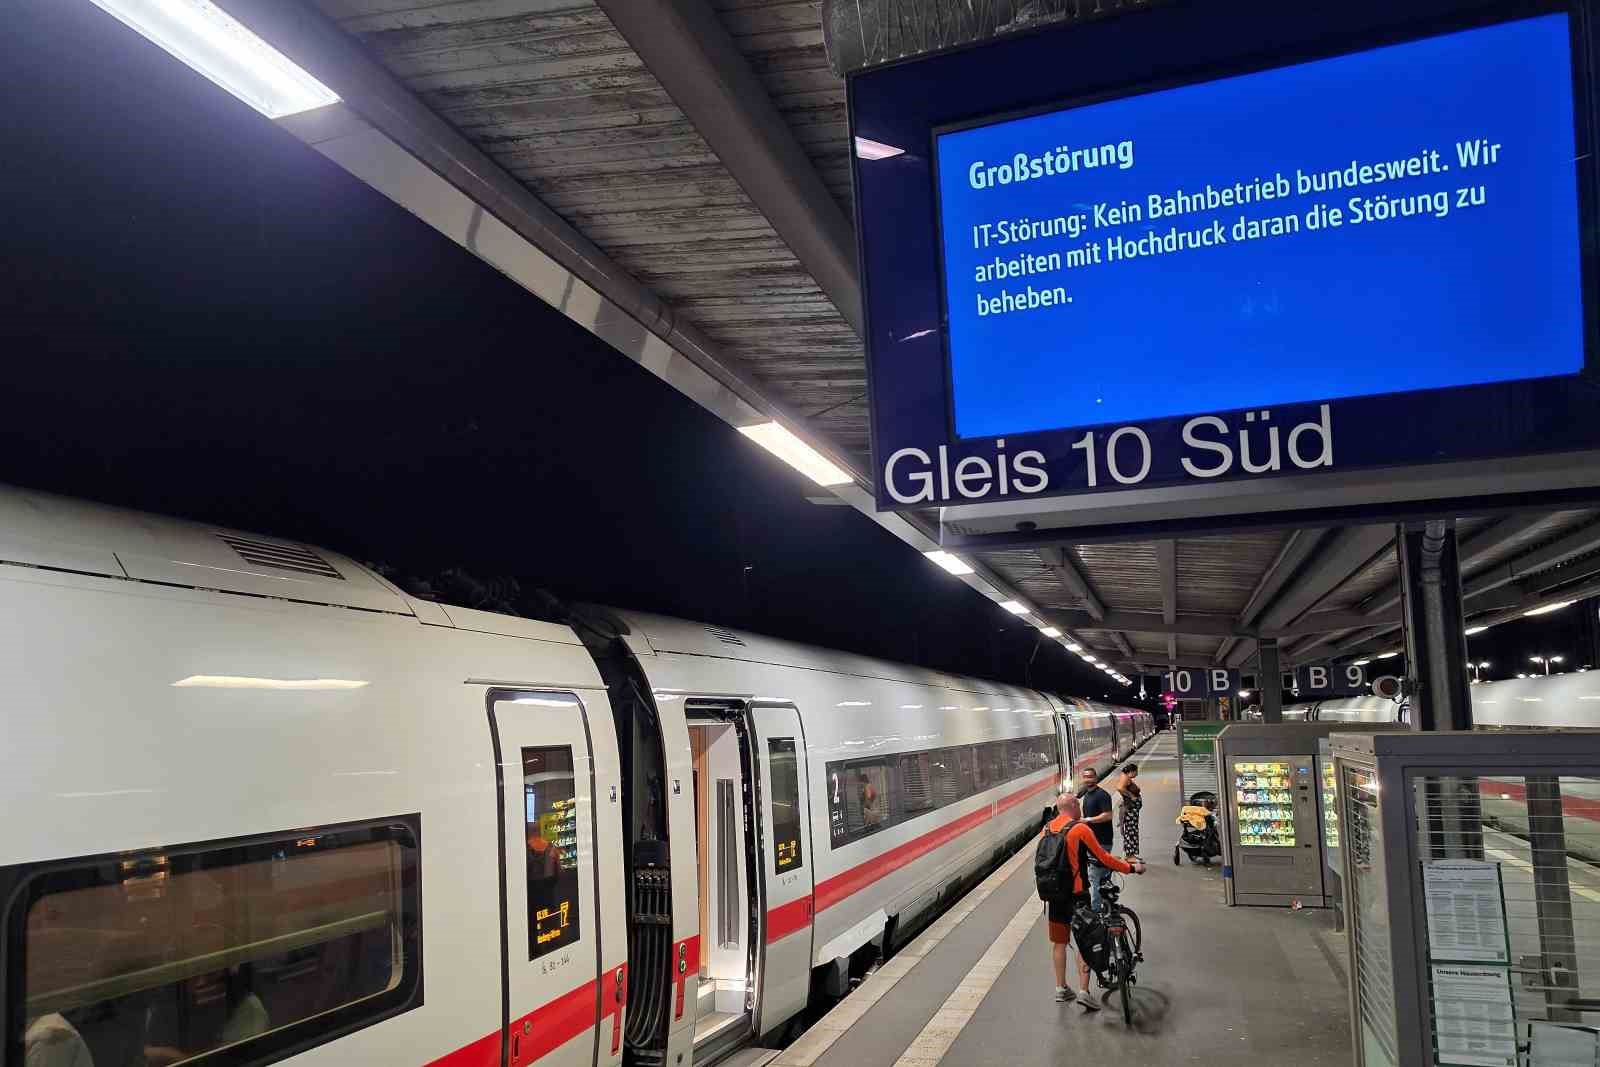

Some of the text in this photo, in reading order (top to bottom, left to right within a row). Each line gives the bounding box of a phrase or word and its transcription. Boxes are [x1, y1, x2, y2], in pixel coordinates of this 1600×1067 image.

[969, 140, 1134, 190] Großstörung
[972, 138, 1502, 249] IT-Störung: Kein Bahnbetrieb bundesweit. Wir
[975, 185, 1486, 283] arbeiten mit Hochdruck daran die Störung zu
[977, 286, 1073, 317] beheben.
[884, 403, 1335, 505] Gleis 10 Süd
[1165, 669, 1231, 693] 10 B
[1309, 665, 1364, 690] B 9
[832, 772, 840, 804] 2
